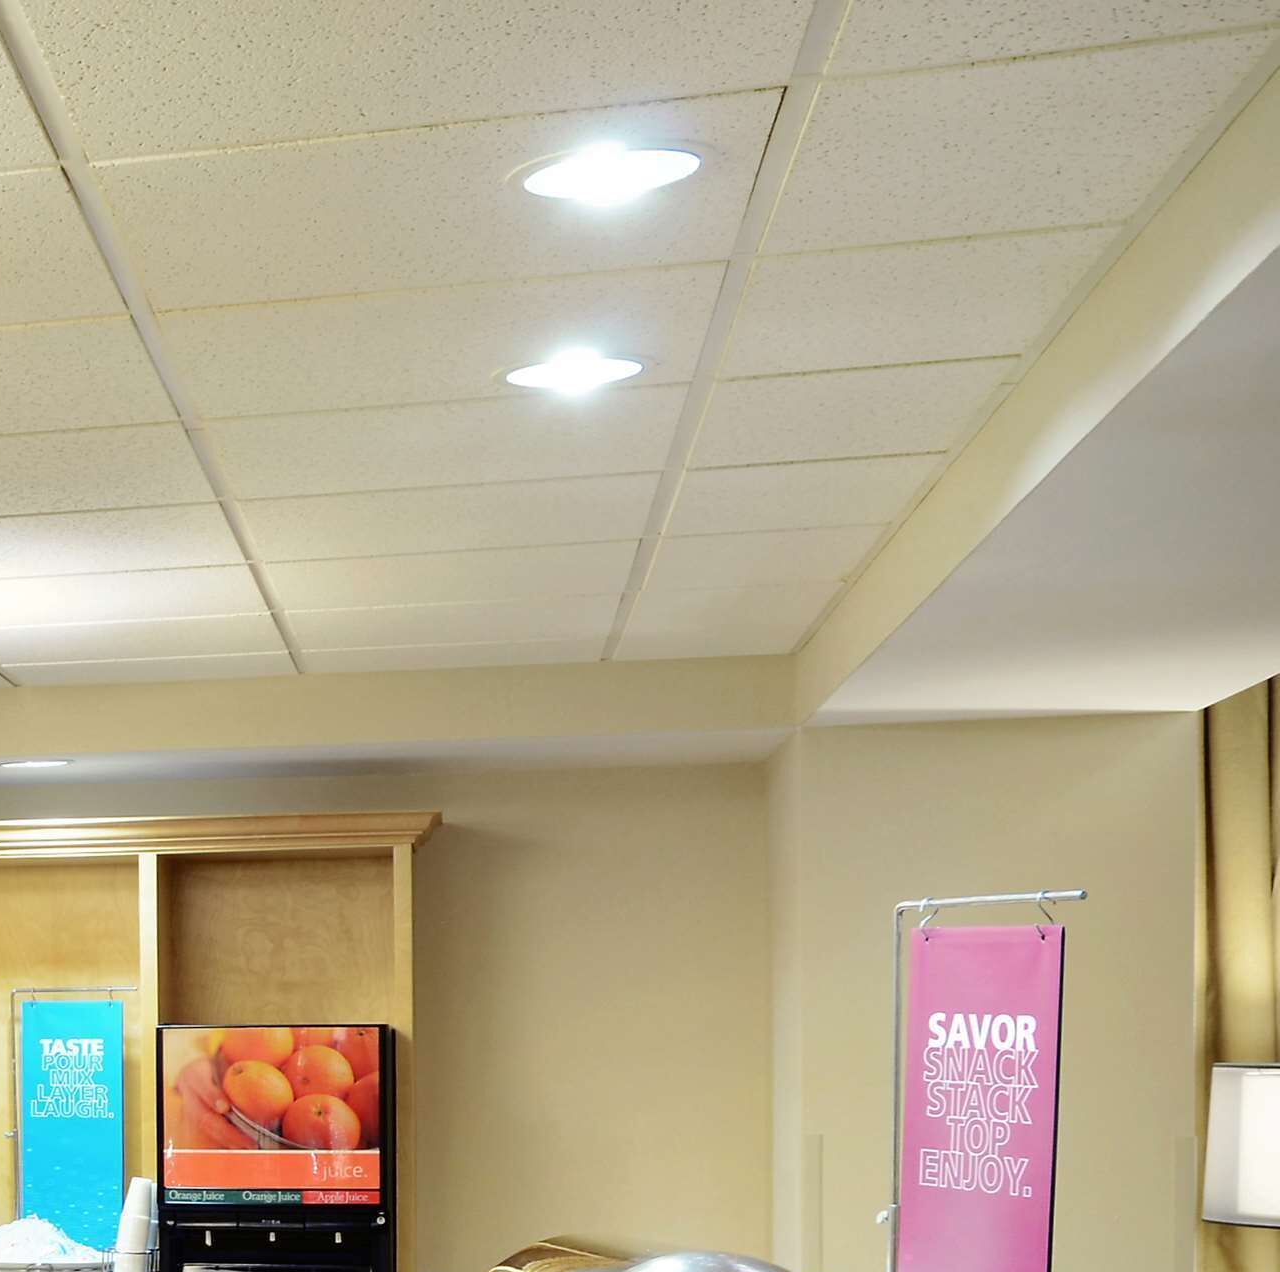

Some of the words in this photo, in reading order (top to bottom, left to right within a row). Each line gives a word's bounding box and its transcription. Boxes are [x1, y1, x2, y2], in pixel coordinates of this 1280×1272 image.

[928, 1012, 1036, 1051] SAVOR
[39, 1039, 103, 1056] TASTE
[41, 1055, 103, 1071] POUR
[923, 1047, 1038, 1087] SNACK
[49, 1070, 94, 1086] MIX
[37, 1085, 108, 1101] LAYER
[31, 1100, 114, 1118] LAUGH.
[927, 1081, 1032, 1124] STACK
[946, 1116, 1010, 1156] TOP
[919, 1149, 1032, 1197] ENJOY.
[168, 1190, 201, 1202] Orange
[202, 1191, 225, 1202] Juice
[242, 1191, 277, 1203] Orange
[278, 1191, 301, 1203] Juice
[317, 1192, 344, 1203] Apple
